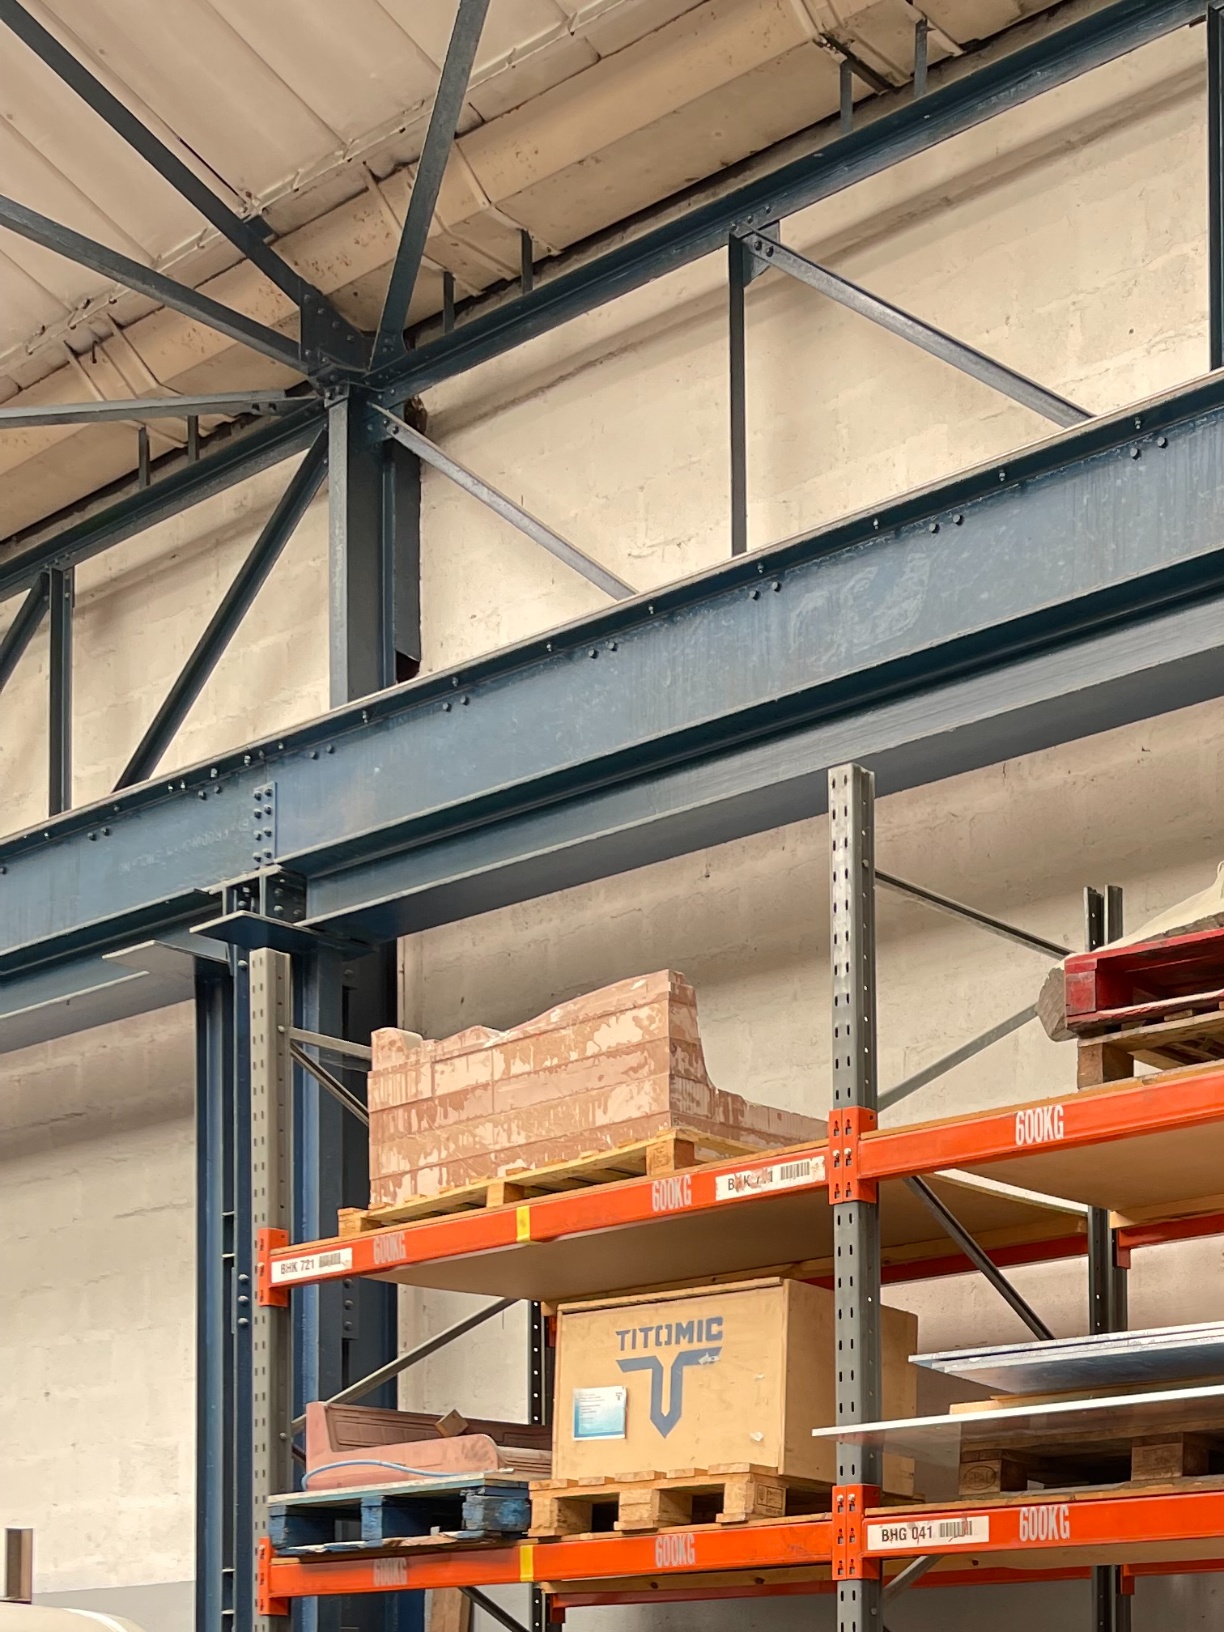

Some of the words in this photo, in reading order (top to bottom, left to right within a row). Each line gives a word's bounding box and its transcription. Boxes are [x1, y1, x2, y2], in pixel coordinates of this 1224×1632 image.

[1015, 1104, 1064, 1146] 600KG
[651, 1174, 692, 1212] 600KG
[727, 1174, 751, 1191] BK
[280, 1262, 298, 1275] BHK
[300, 1259, 315, 1271] 721
[616, 1316, 723, 1351] TITOMIC
[881, 1527, 907, 1542] BHG
[912, 1526, 933, 1540] 041
[1019, 1505, 1070, 1541] 600KG
[655, 1533, 695, 1568] 600KG
